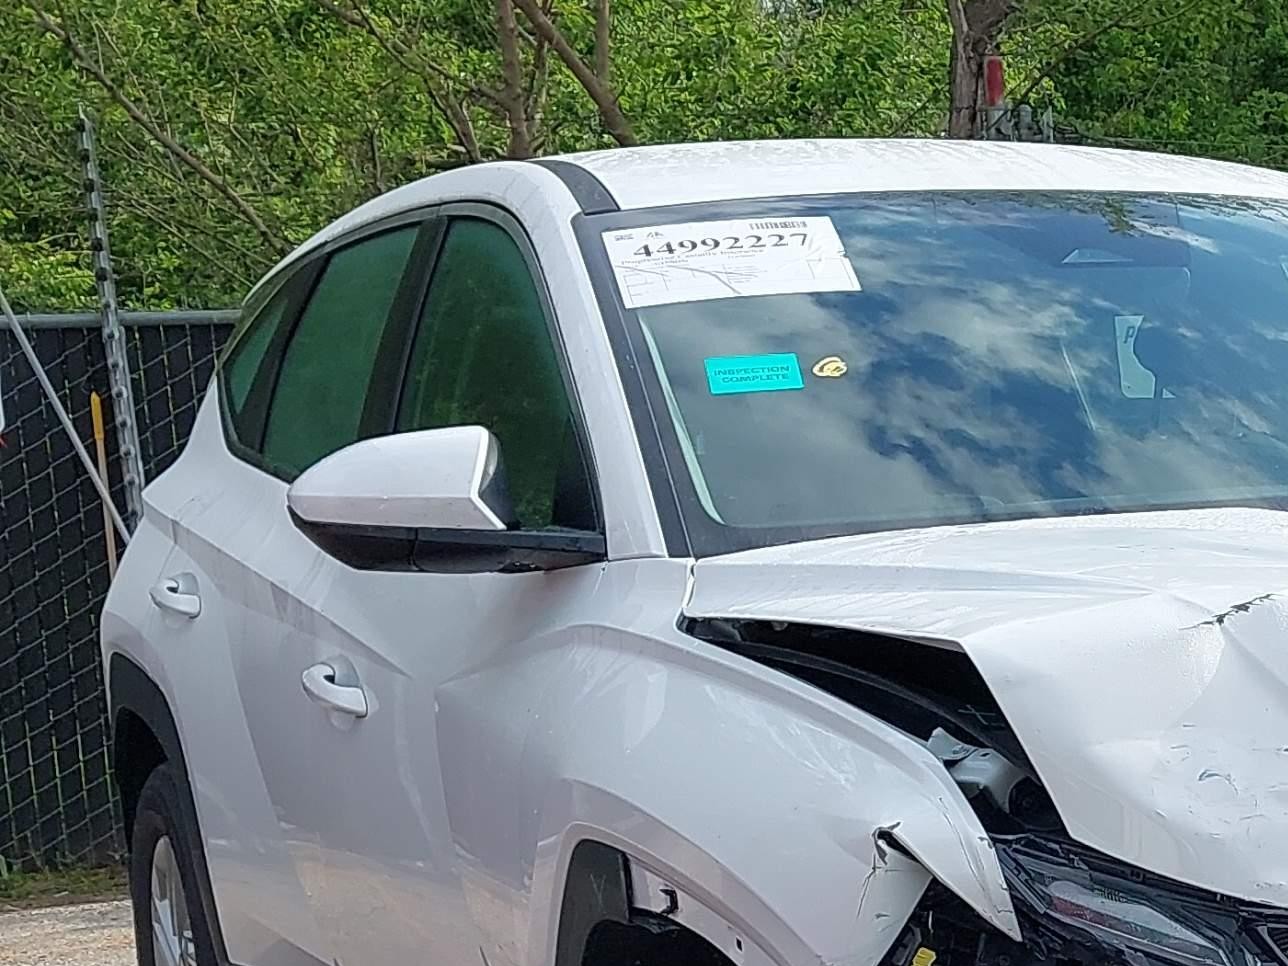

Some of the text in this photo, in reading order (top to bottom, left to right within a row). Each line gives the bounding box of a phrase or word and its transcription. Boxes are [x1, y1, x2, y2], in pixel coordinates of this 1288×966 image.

[633, 232, 808, 257] 44992227
[713, 364, 790, 376] INSPECTION
[720, 373, 790, 383] COMPLETE
